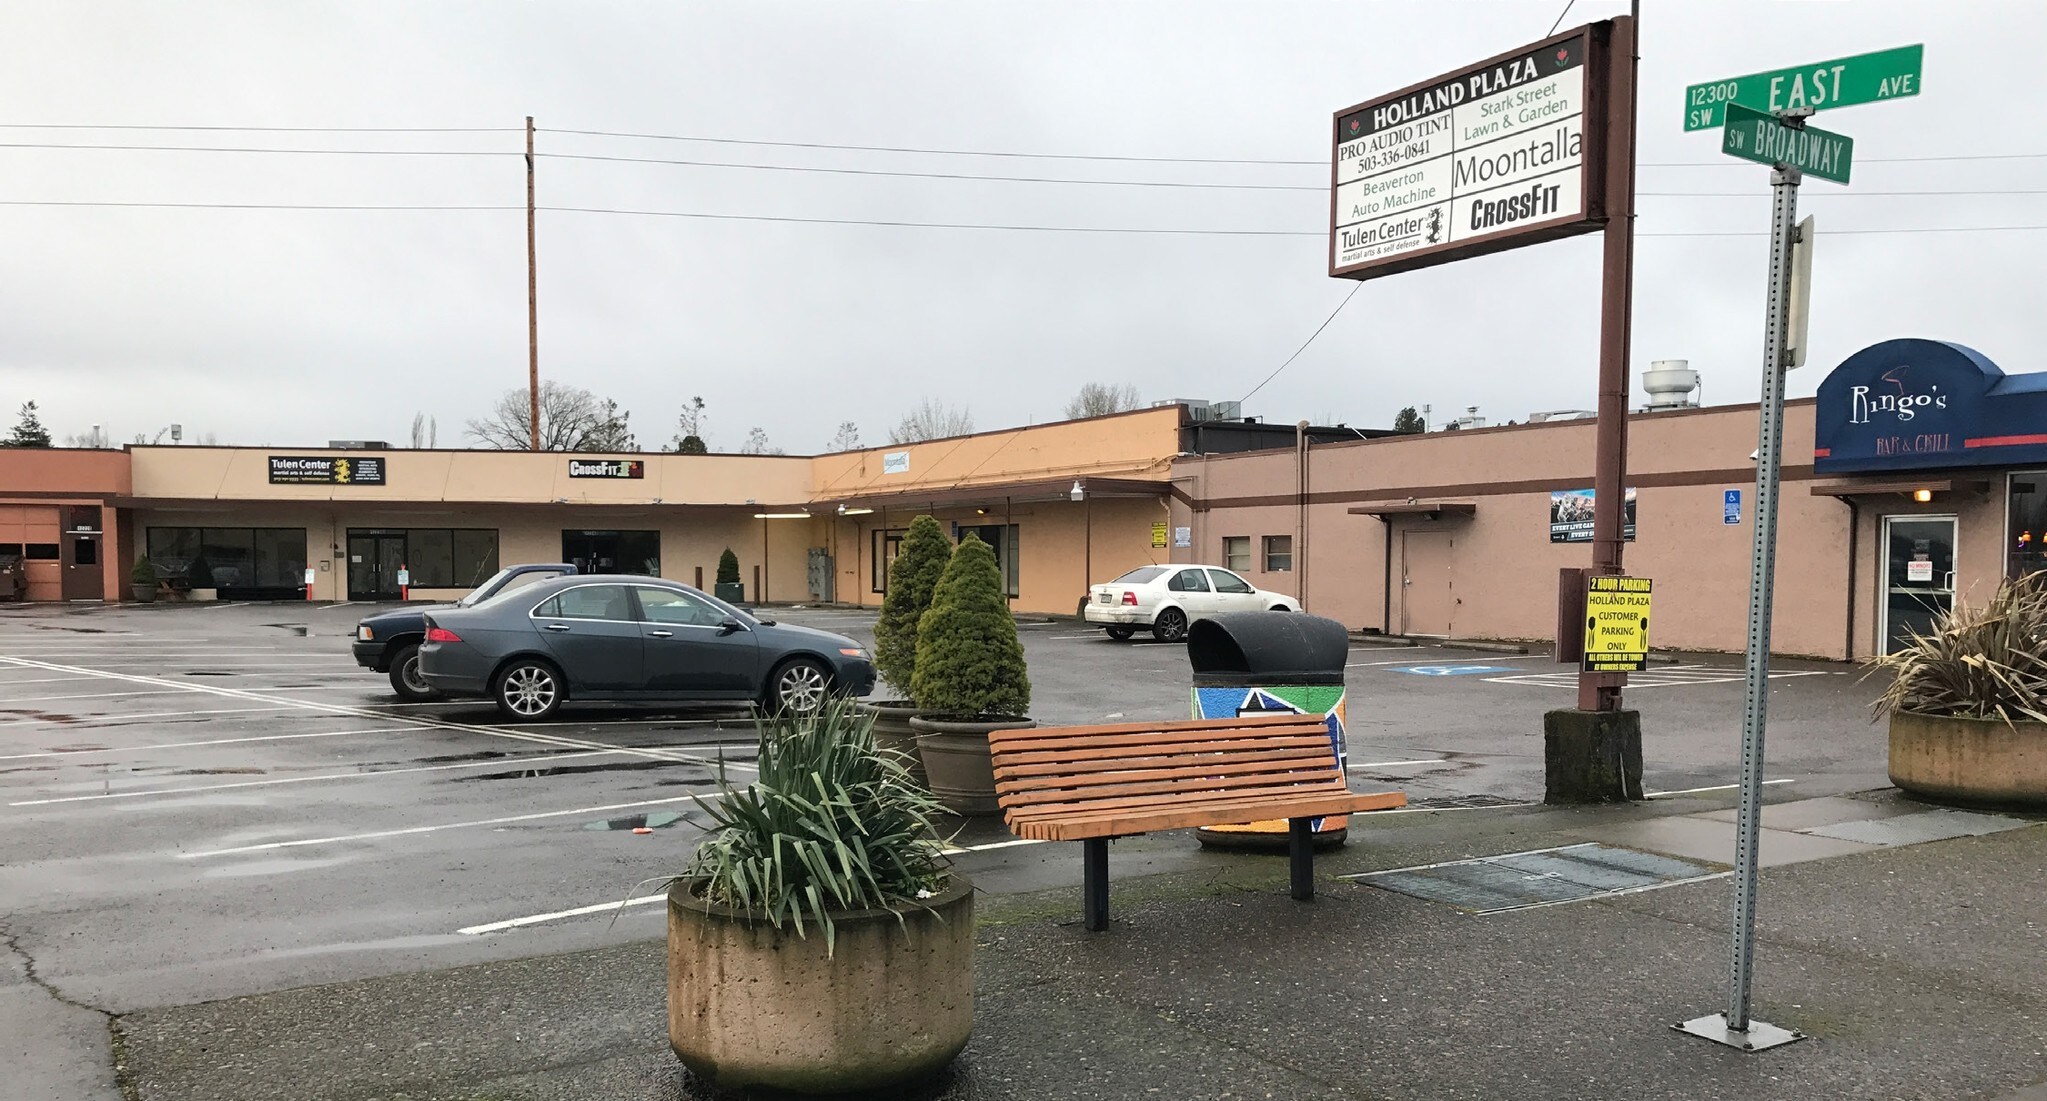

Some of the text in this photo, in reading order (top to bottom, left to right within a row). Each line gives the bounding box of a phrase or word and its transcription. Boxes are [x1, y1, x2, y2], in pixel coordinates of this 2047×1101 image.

[1374, 56, 1538, 130] HOLLAND PLAZA
[1481, 82, 1557, 118] Stark Street
[1692, 82, 1738, 107] 12300
[1768, 65, 1914, 112] EAST AVE
[1464, 99, 1568, 141] Lawn & Garden
[1690, 108, 1713, 128] SW
[1340, 114, 1450, 161] PRO AUDIO TINT
[1729, 119, 1843, 175] SW BROADWAY
[1358, 139, 1430, 173] 503-336-0841
[1454, 126, 1582, 188] Moontalla
[1363, 171, 1424, 196] Beaverton
[1352, 186, 1436, 218] Auto Machine
[1341, 217, 1423, 248] Tulen Center
[1342, 250, 1362, 262] martial
[1363, 249, 1375, 258] arts
[1383, 244, 1394, 254] self
[1395, 239, 1420, 250] defense
[1849, 385, 1946, 424] Ringo's
[1876, 433, 1949, 455] BAR & GRILL
[271, 459, 331, 469] Tulen Center
[1591, 577, 1651, 592] 2 HOUR PARKING
[1589, 596, 1650, 606] HOLLAND PLAZA
[1598, 611, 1639, 621] CUSTOMER
[1601, 626, 1634, 635] PARKING
[1607, 642, 1627, 650] ONLY
